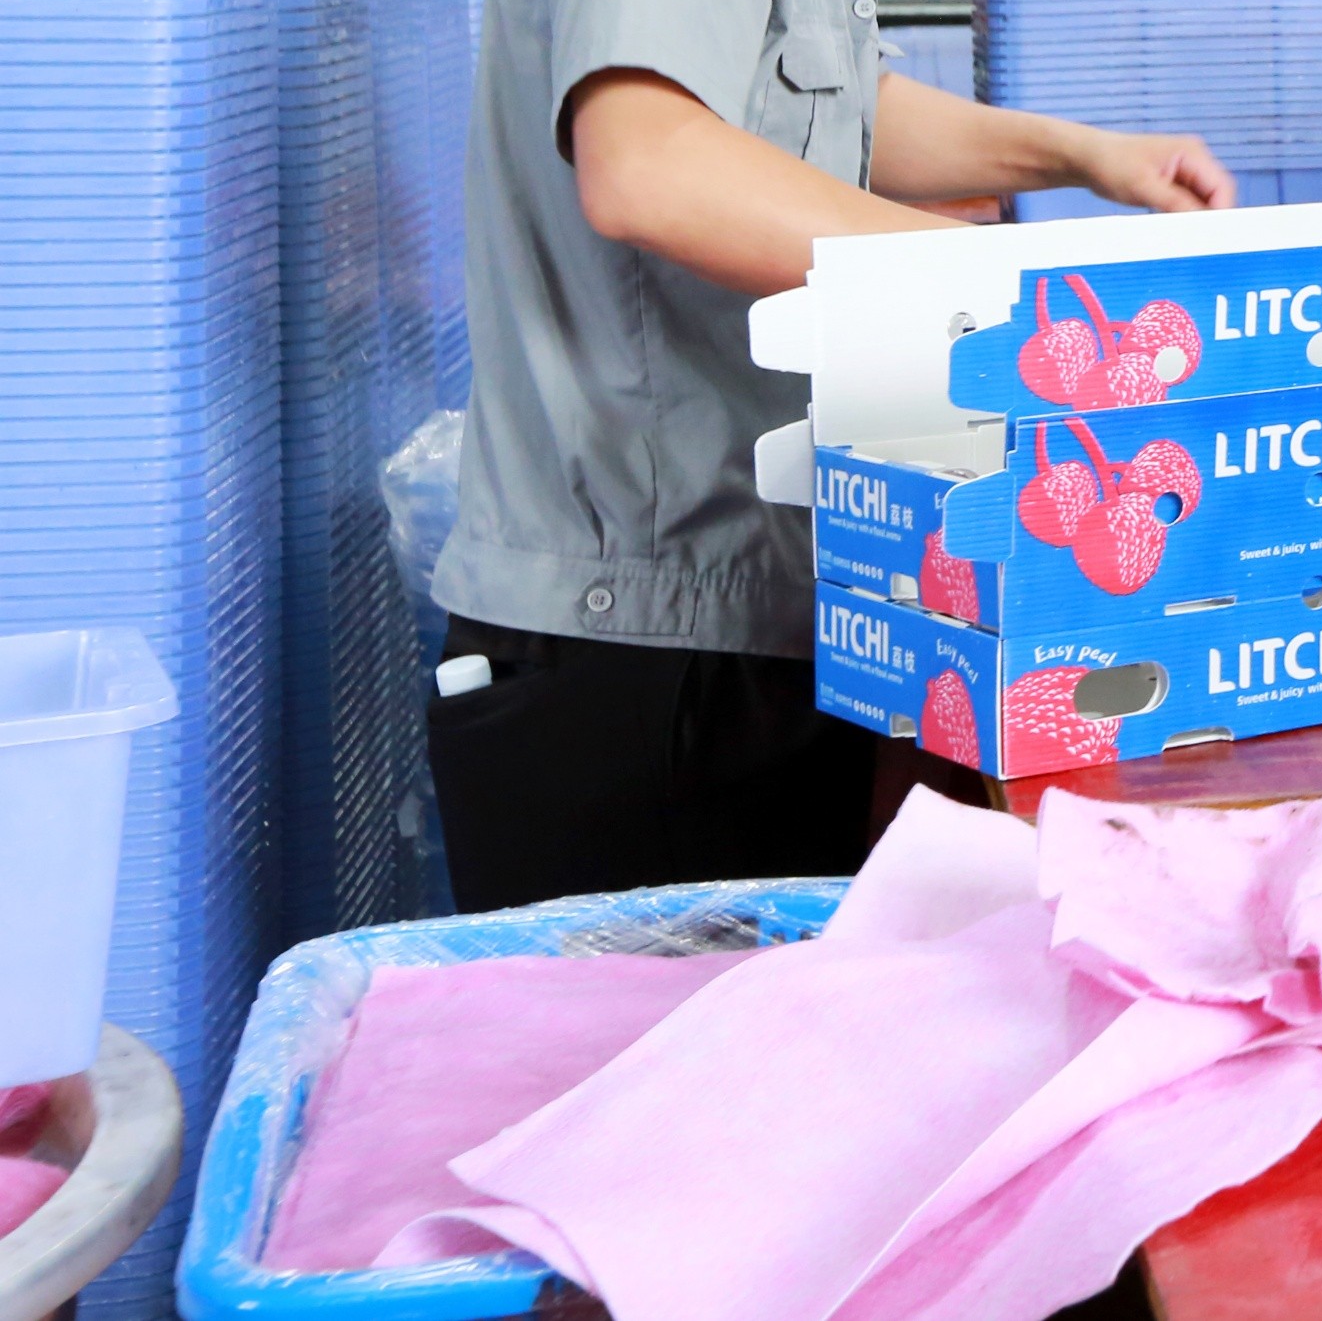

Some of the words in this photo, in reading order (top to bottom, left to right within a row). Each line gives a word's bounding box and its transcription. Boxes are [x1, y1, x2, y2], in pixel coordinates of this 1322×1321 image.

[816, 466, 887, 523] LITCHI
[1240, 547, 1272, 560] Sweet
[1272, 545, 1281, 556] &
[1281, 542, 1306, 557] juicy
[819, 601, 889, 664] LITCHI
[937, 637, 957, 663] Easy
[957, 653, 979, 684] peel
[1034, 644, 1075, 664] Easy
[1077, 645, 1118, 667] peel
[1237, 691, 1268, 706] Sweet
[1270, 689, 1278, 700] &
[1279, 686, 1304, 701] juicy
